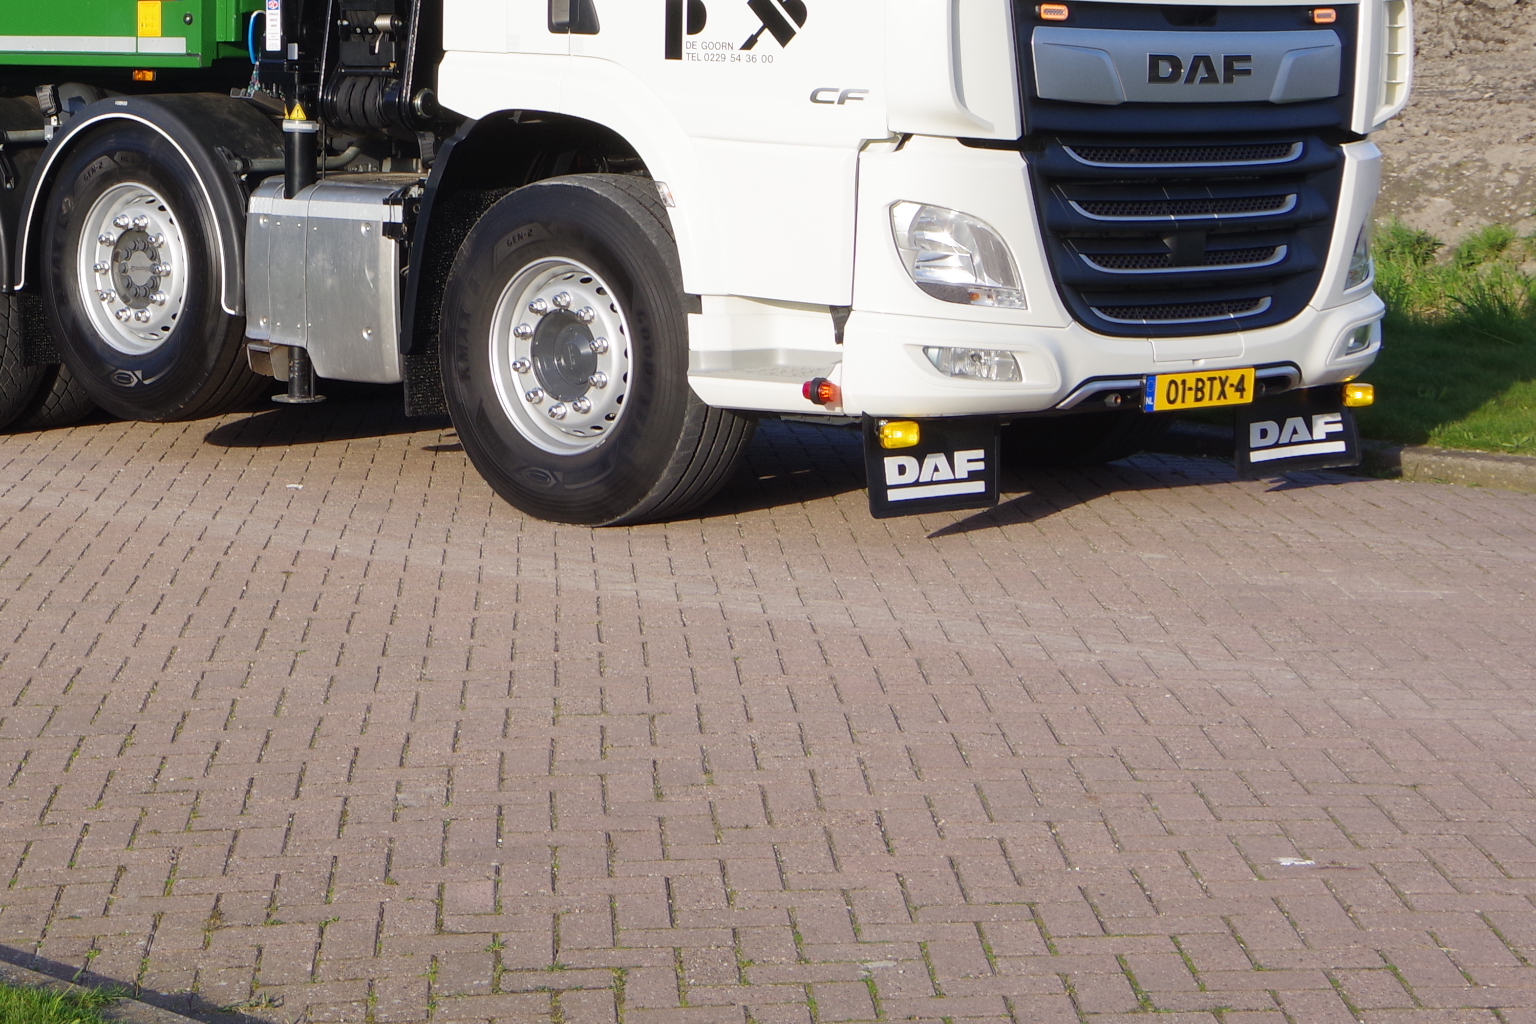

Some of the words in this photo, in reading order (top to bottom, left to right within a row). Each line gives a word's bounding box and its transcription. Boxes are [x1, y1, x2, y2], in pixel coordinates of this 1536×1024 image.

[685, 41, 697, 50] DE
[701, 41, 734, 51] GOORN
[685, 53, 701, 62] TEL
[704, 53, 727, 63] 0229
[730, 53, 741, 63] 54
[745, 54, 757, 63] 36
[761, 54, 774, 63] 00
[1146, 53, 1253, 85] DAF
[809, 87, 870, 105] CF
[83, 161, 104, 182] GEN-2
[506, 228, 533, 247] GEN-2
[1145, 397, 1153, 405] NL
[1166, 373, 1246, 405] 01-BTX-4
[1249, 411, 1344, 449] DAF
[883, 448, 985, 486] DAF
